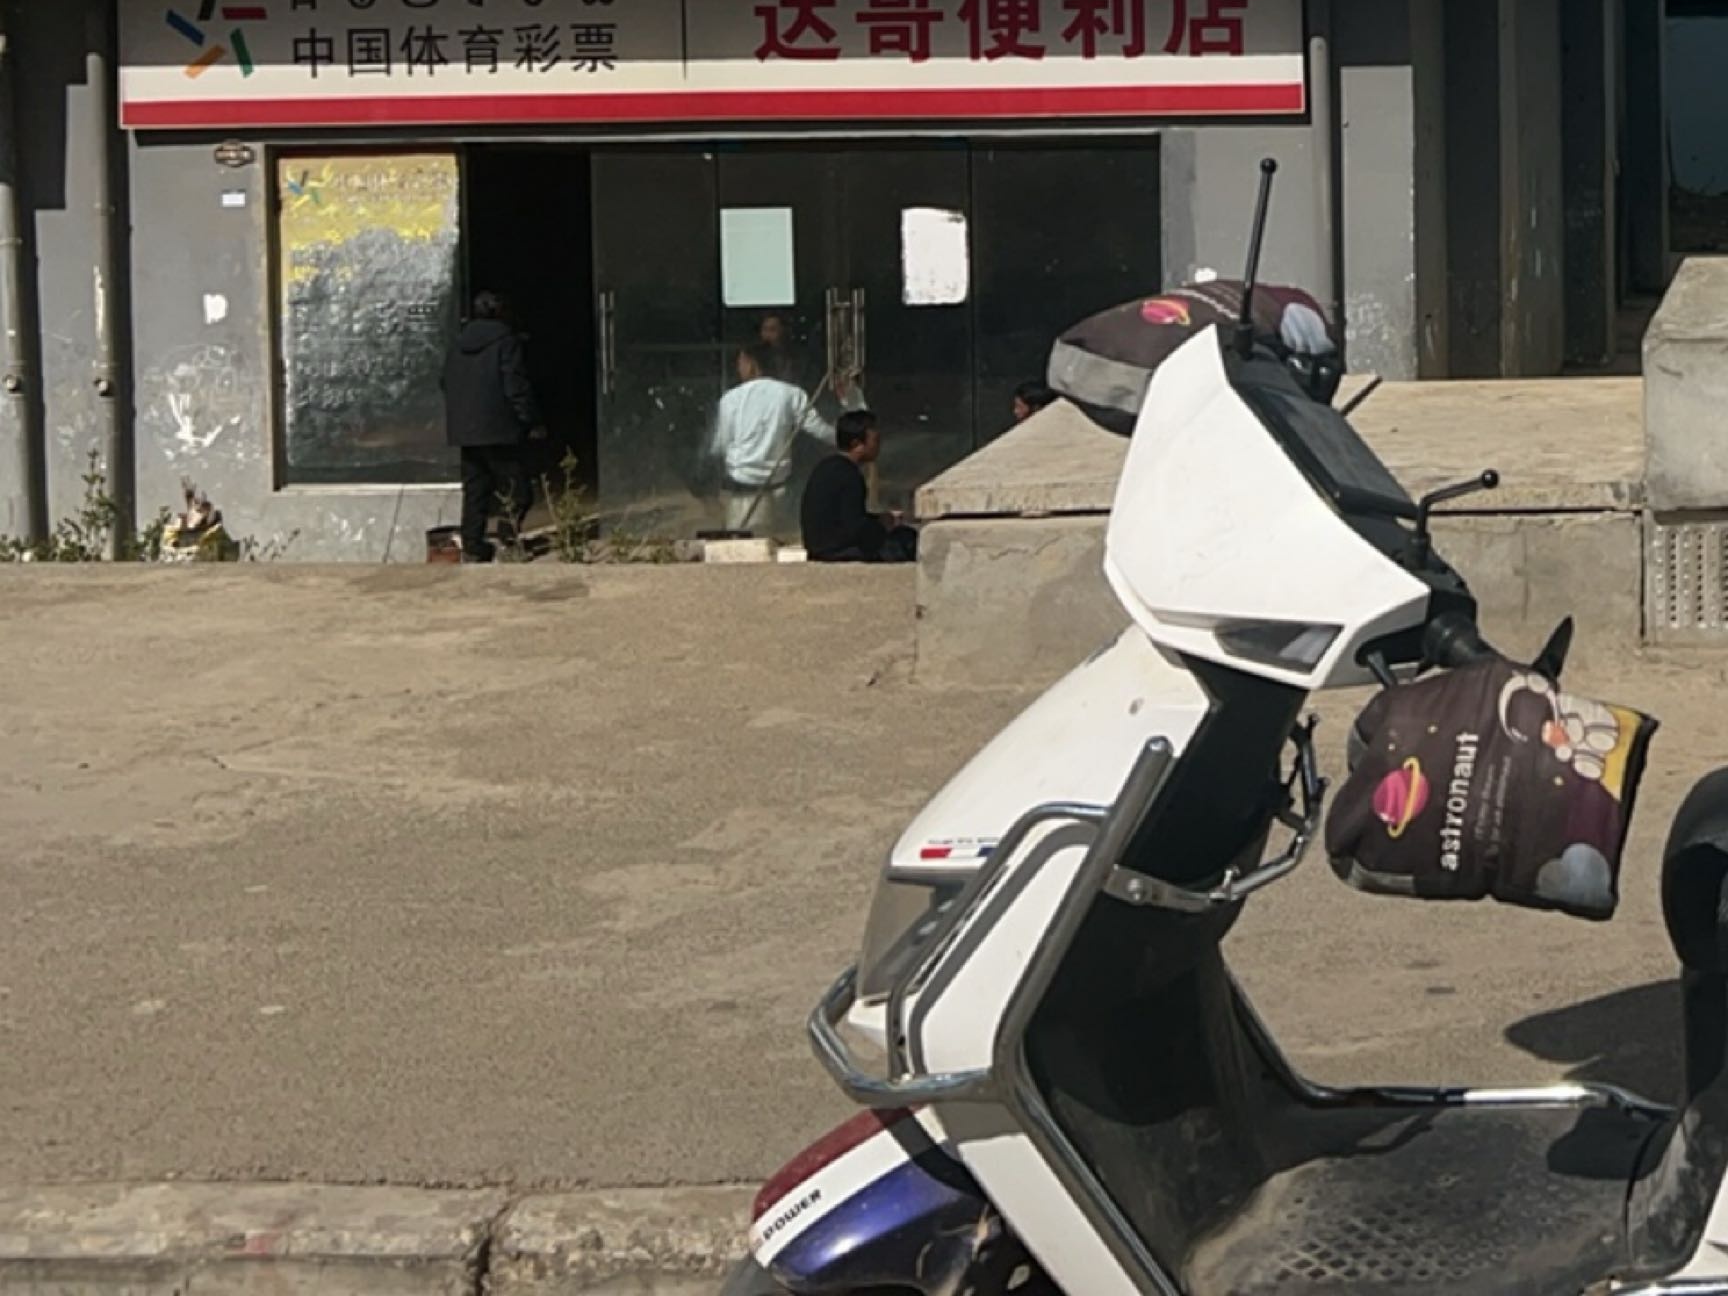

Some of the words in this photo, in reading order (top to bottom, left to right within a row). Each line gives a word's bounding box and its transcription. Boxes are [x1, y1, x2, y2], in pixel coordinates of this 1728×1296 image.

[292, 23, 618, 79] 中国体育彩票
[1440, 732, 1479, 872] astronaut
[763, 1189, 821, 1240] POWER
